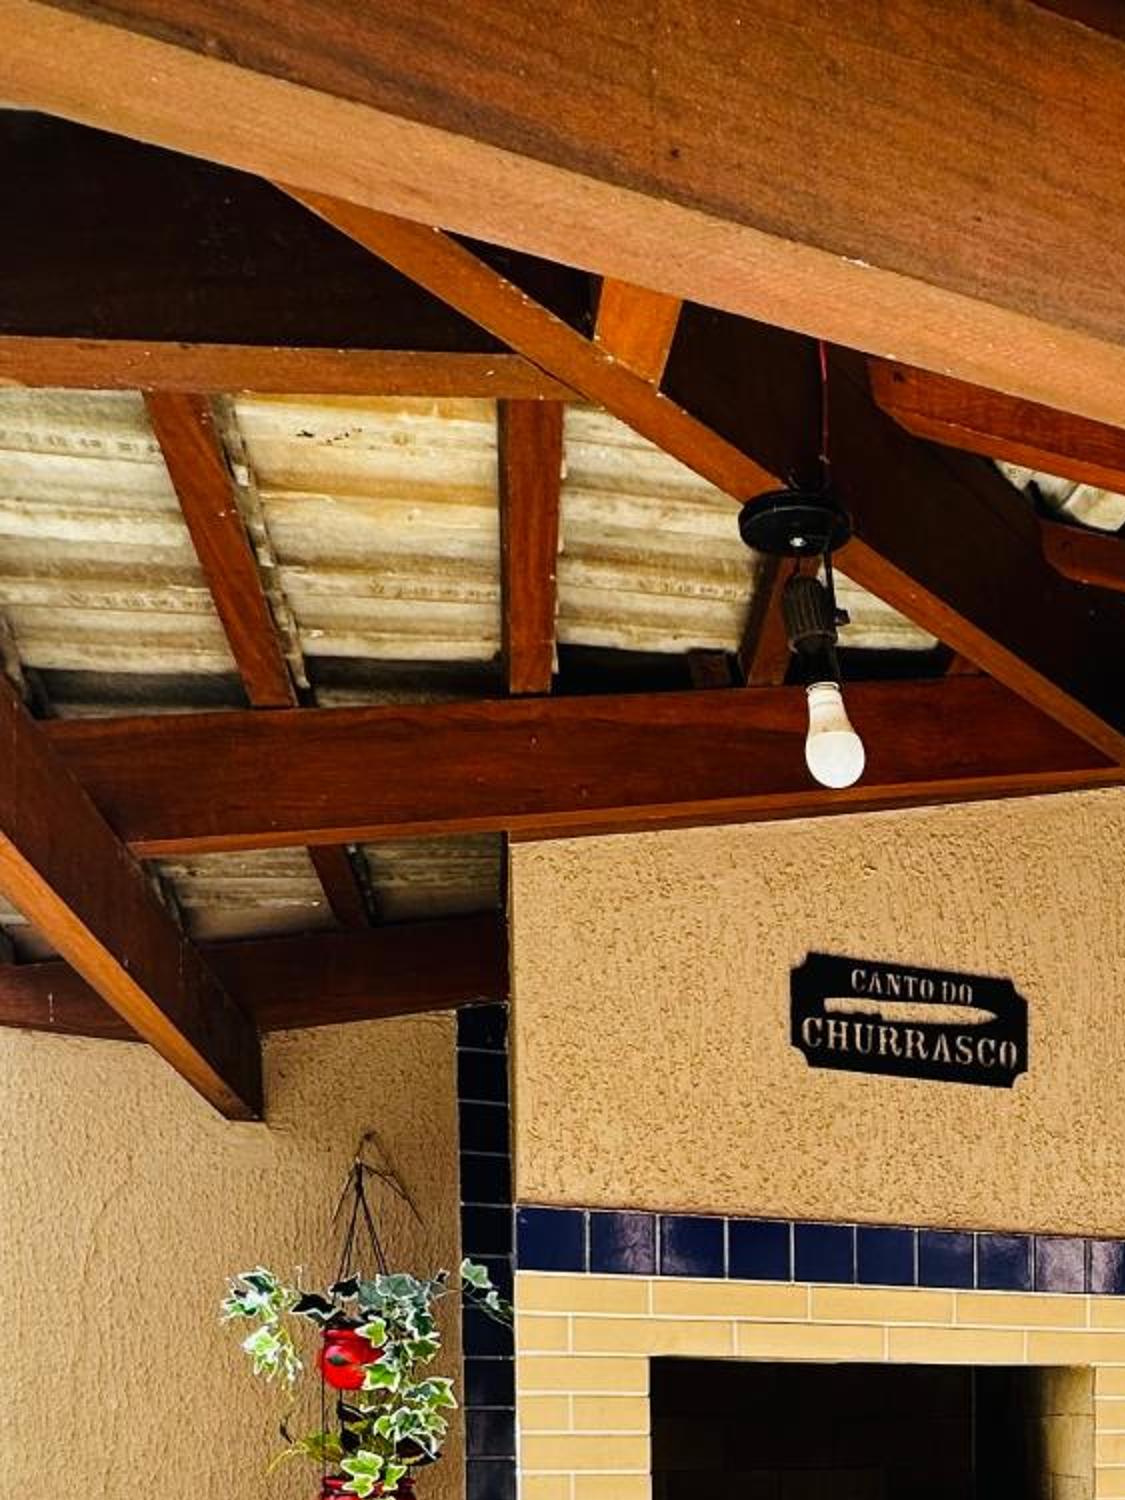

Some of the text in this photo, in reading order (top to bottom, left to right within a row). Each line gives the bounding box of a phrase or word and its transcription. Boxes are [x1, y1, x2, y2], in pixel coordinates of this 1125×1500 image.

[851, 968, 973, 1005] CANTO DO
[802, 1016, 1018, 1070] CHURRASCO
